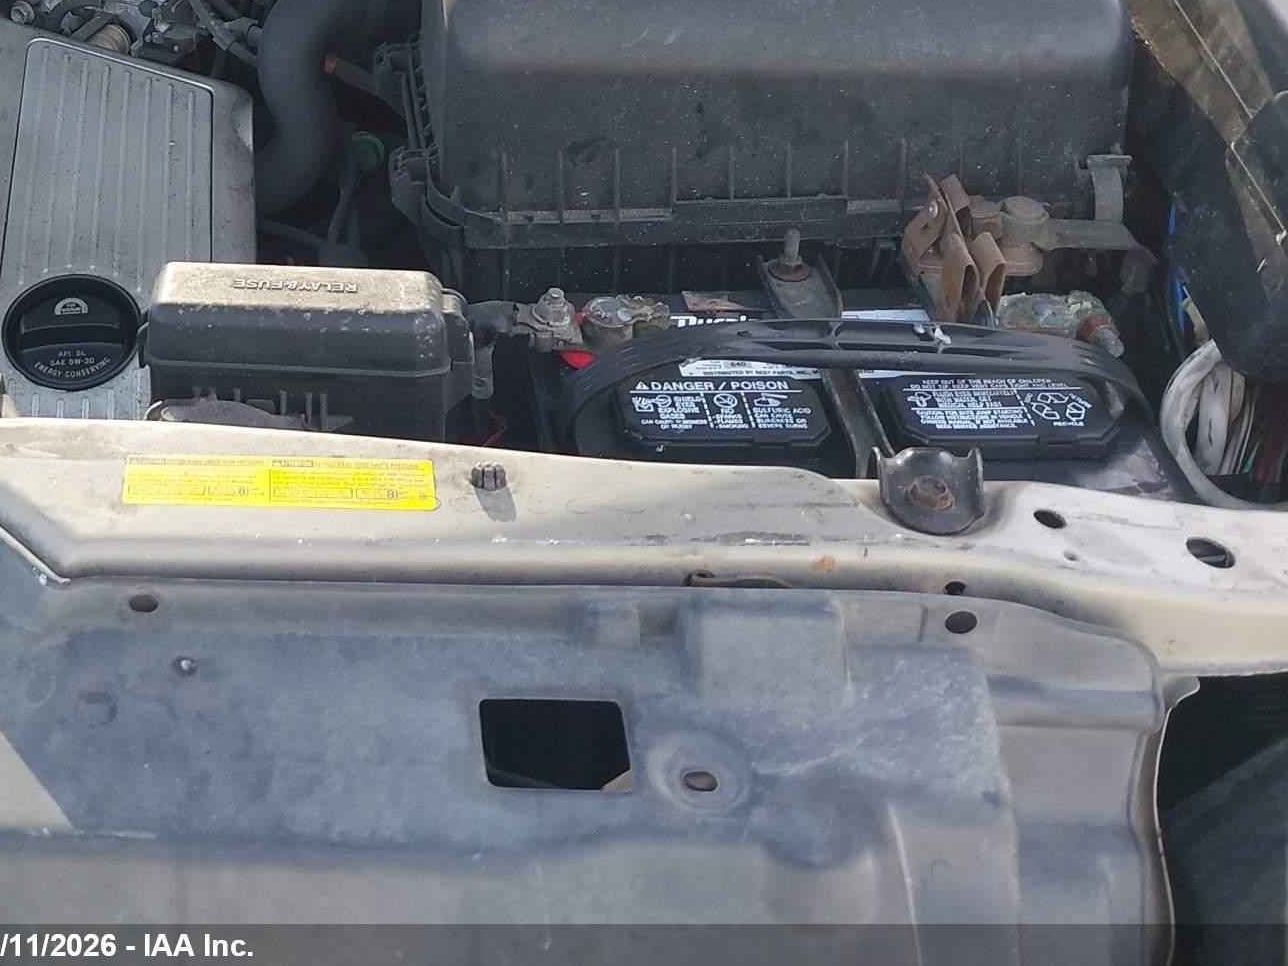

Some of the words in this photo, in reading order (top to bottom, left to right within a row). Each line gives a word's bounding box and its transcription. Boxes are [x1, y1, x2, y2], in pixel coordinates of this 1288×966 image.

[34, 361, 62, 378] ENERGY
[65, 356, 111, 378] CONSERVING
[50, 358, 66, 367] SAE
[69, 357, 95, 365] 5W-30
[651, 381, 715, 391] DANGER
[730, 380, 789, 390] POISON
